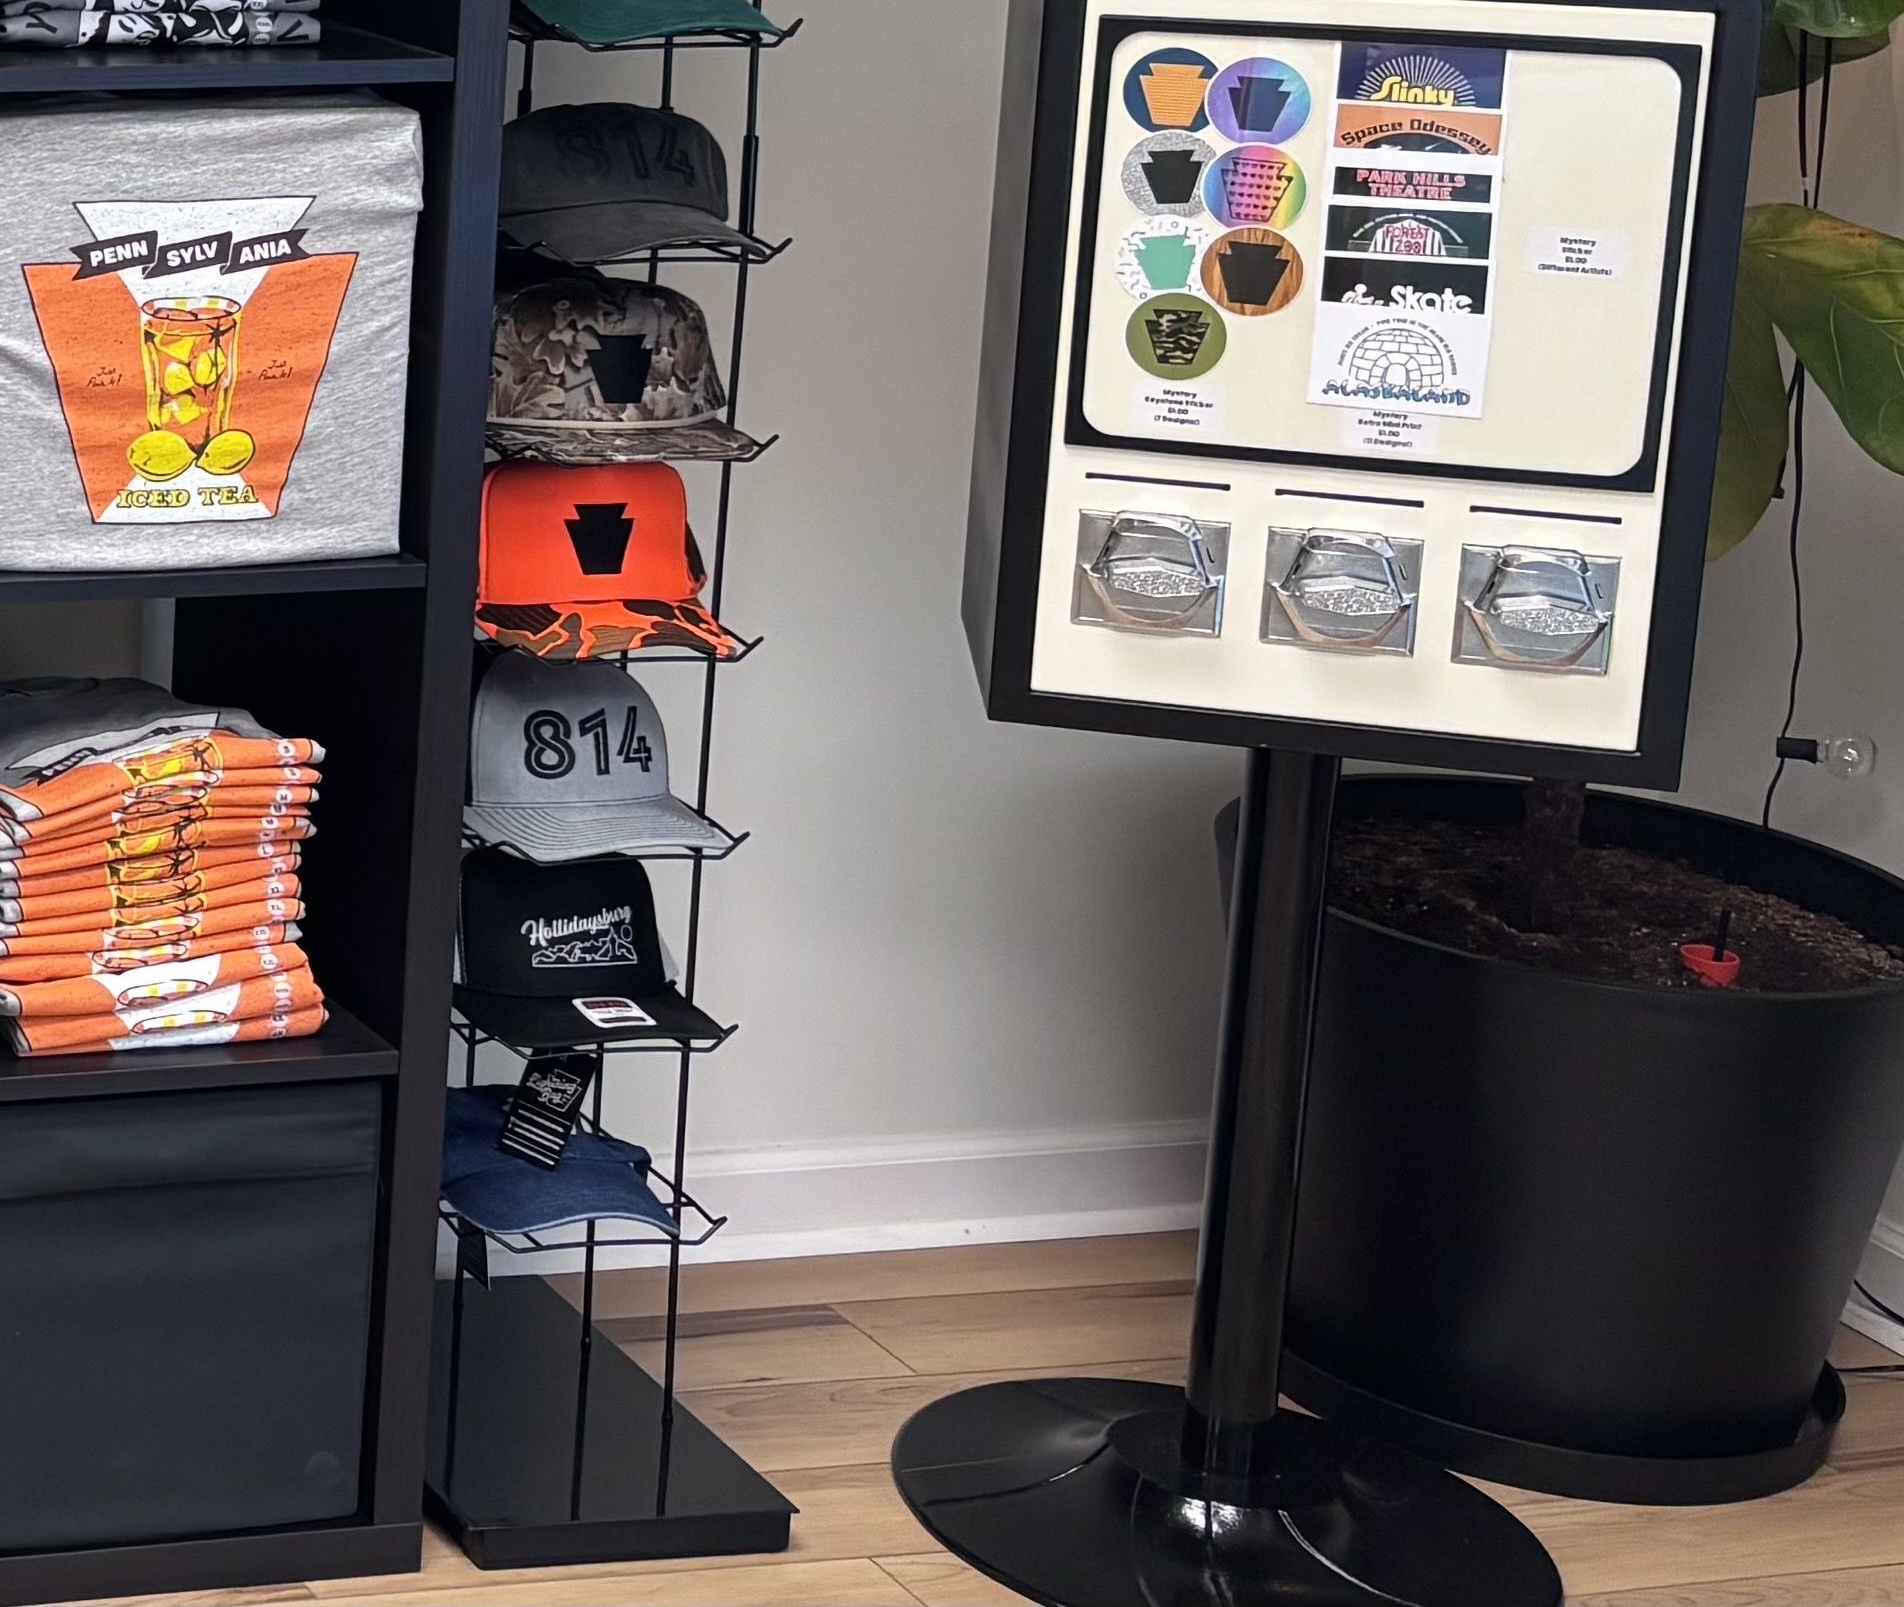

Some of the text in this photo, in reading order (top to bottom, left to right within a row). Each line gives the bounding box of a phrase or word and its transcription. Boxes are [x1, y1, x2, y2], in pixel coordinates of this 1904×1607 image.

[1370, 76, 1455, 107] Slinky
[1341, 122, 1403, 146] Space
[556, 121, 696, 187] 814
[1356, 169, 1466, 187] PARK HILLS
[1368, 183, 1452, 200] THEATRE
[1385, 225, 1429, 240] FOREST
[90, 238, 292, 267] PENN SYLV ANIA
[1394, 239, 1422, 255] ZOO
[1390, 285, 1473, 314] Skate
[1321, 379, 1471, 407] ALASKALAND
[117, 485, 259, 509] ICED TEA
[523, 705, 653, 779] 814
[521, 903, 633, 947] Hollidaysburg
